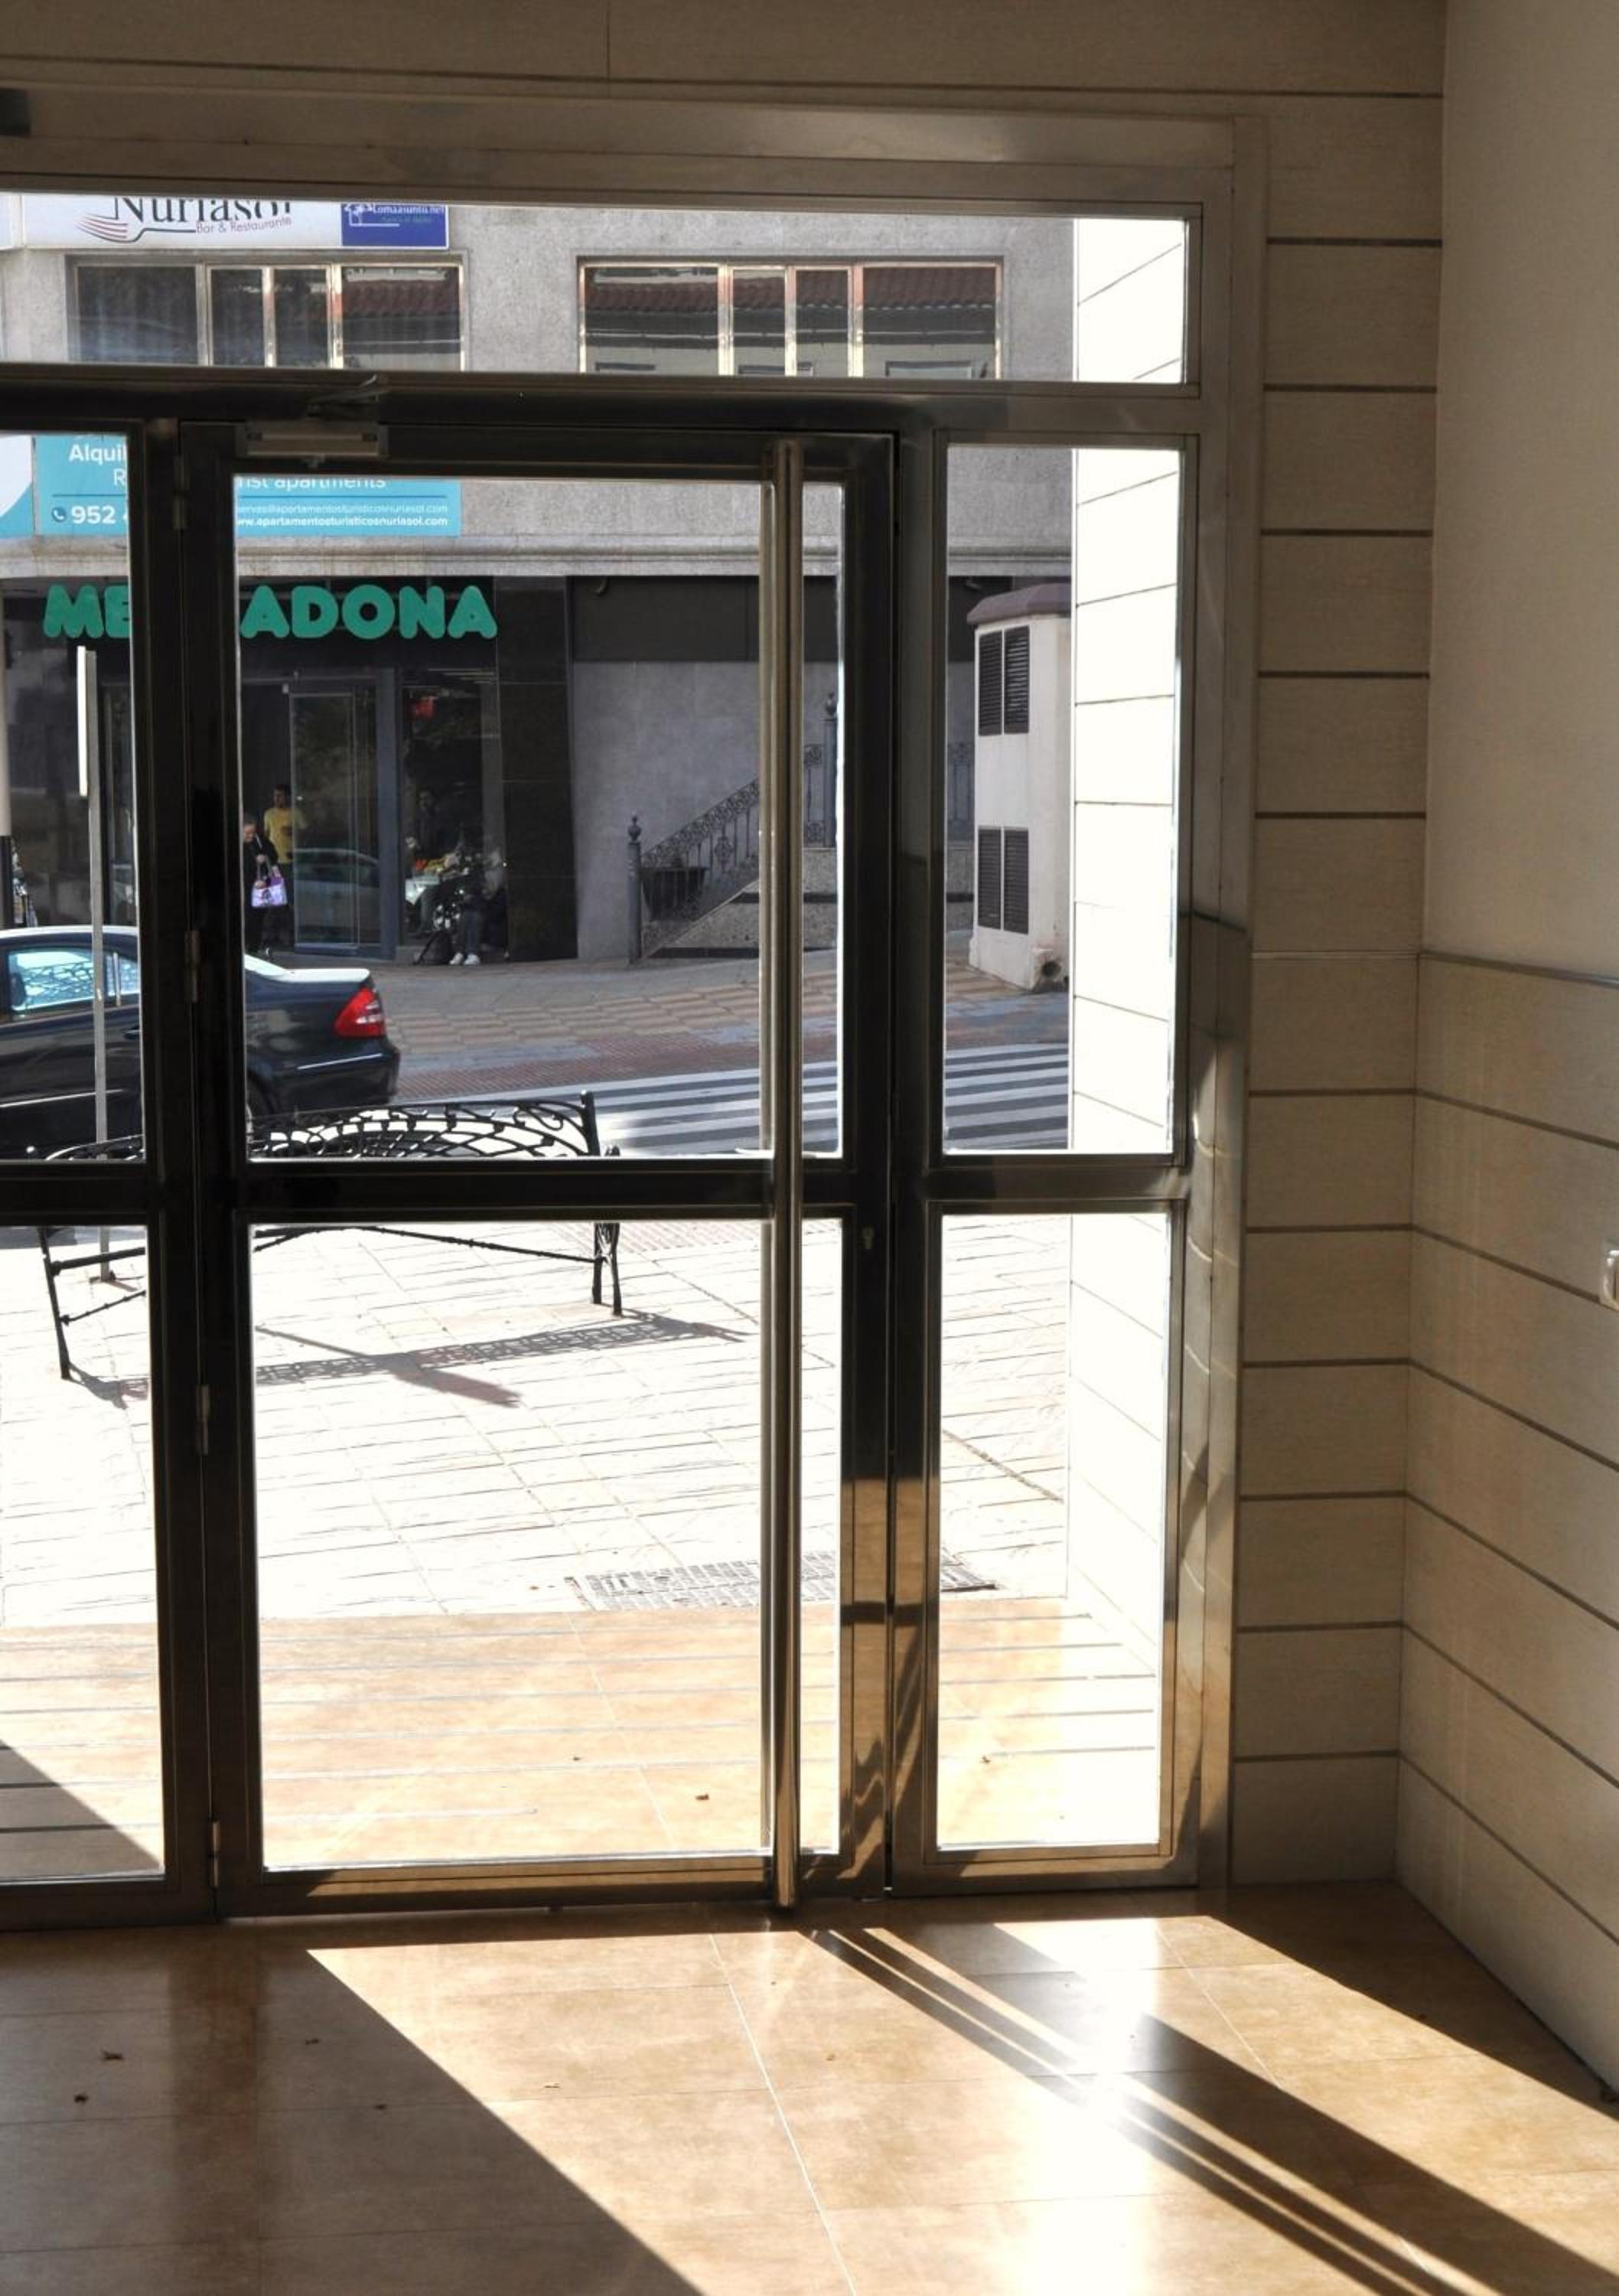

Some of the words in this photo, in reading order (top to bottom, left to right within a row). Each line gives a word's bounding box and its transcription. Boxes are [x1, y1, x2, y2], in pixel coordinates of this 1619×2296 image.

[197, 221, 214, 233] Bar
[218, 221, 226, 233] &
[230, 217, 292, 233] Restaurante
[68, 444, 127, 465] Alquil
[274, 478, 386, 491] apartments
[72, 506, 116, 523] 952
[44, 584, 497, 639] MEADONA
